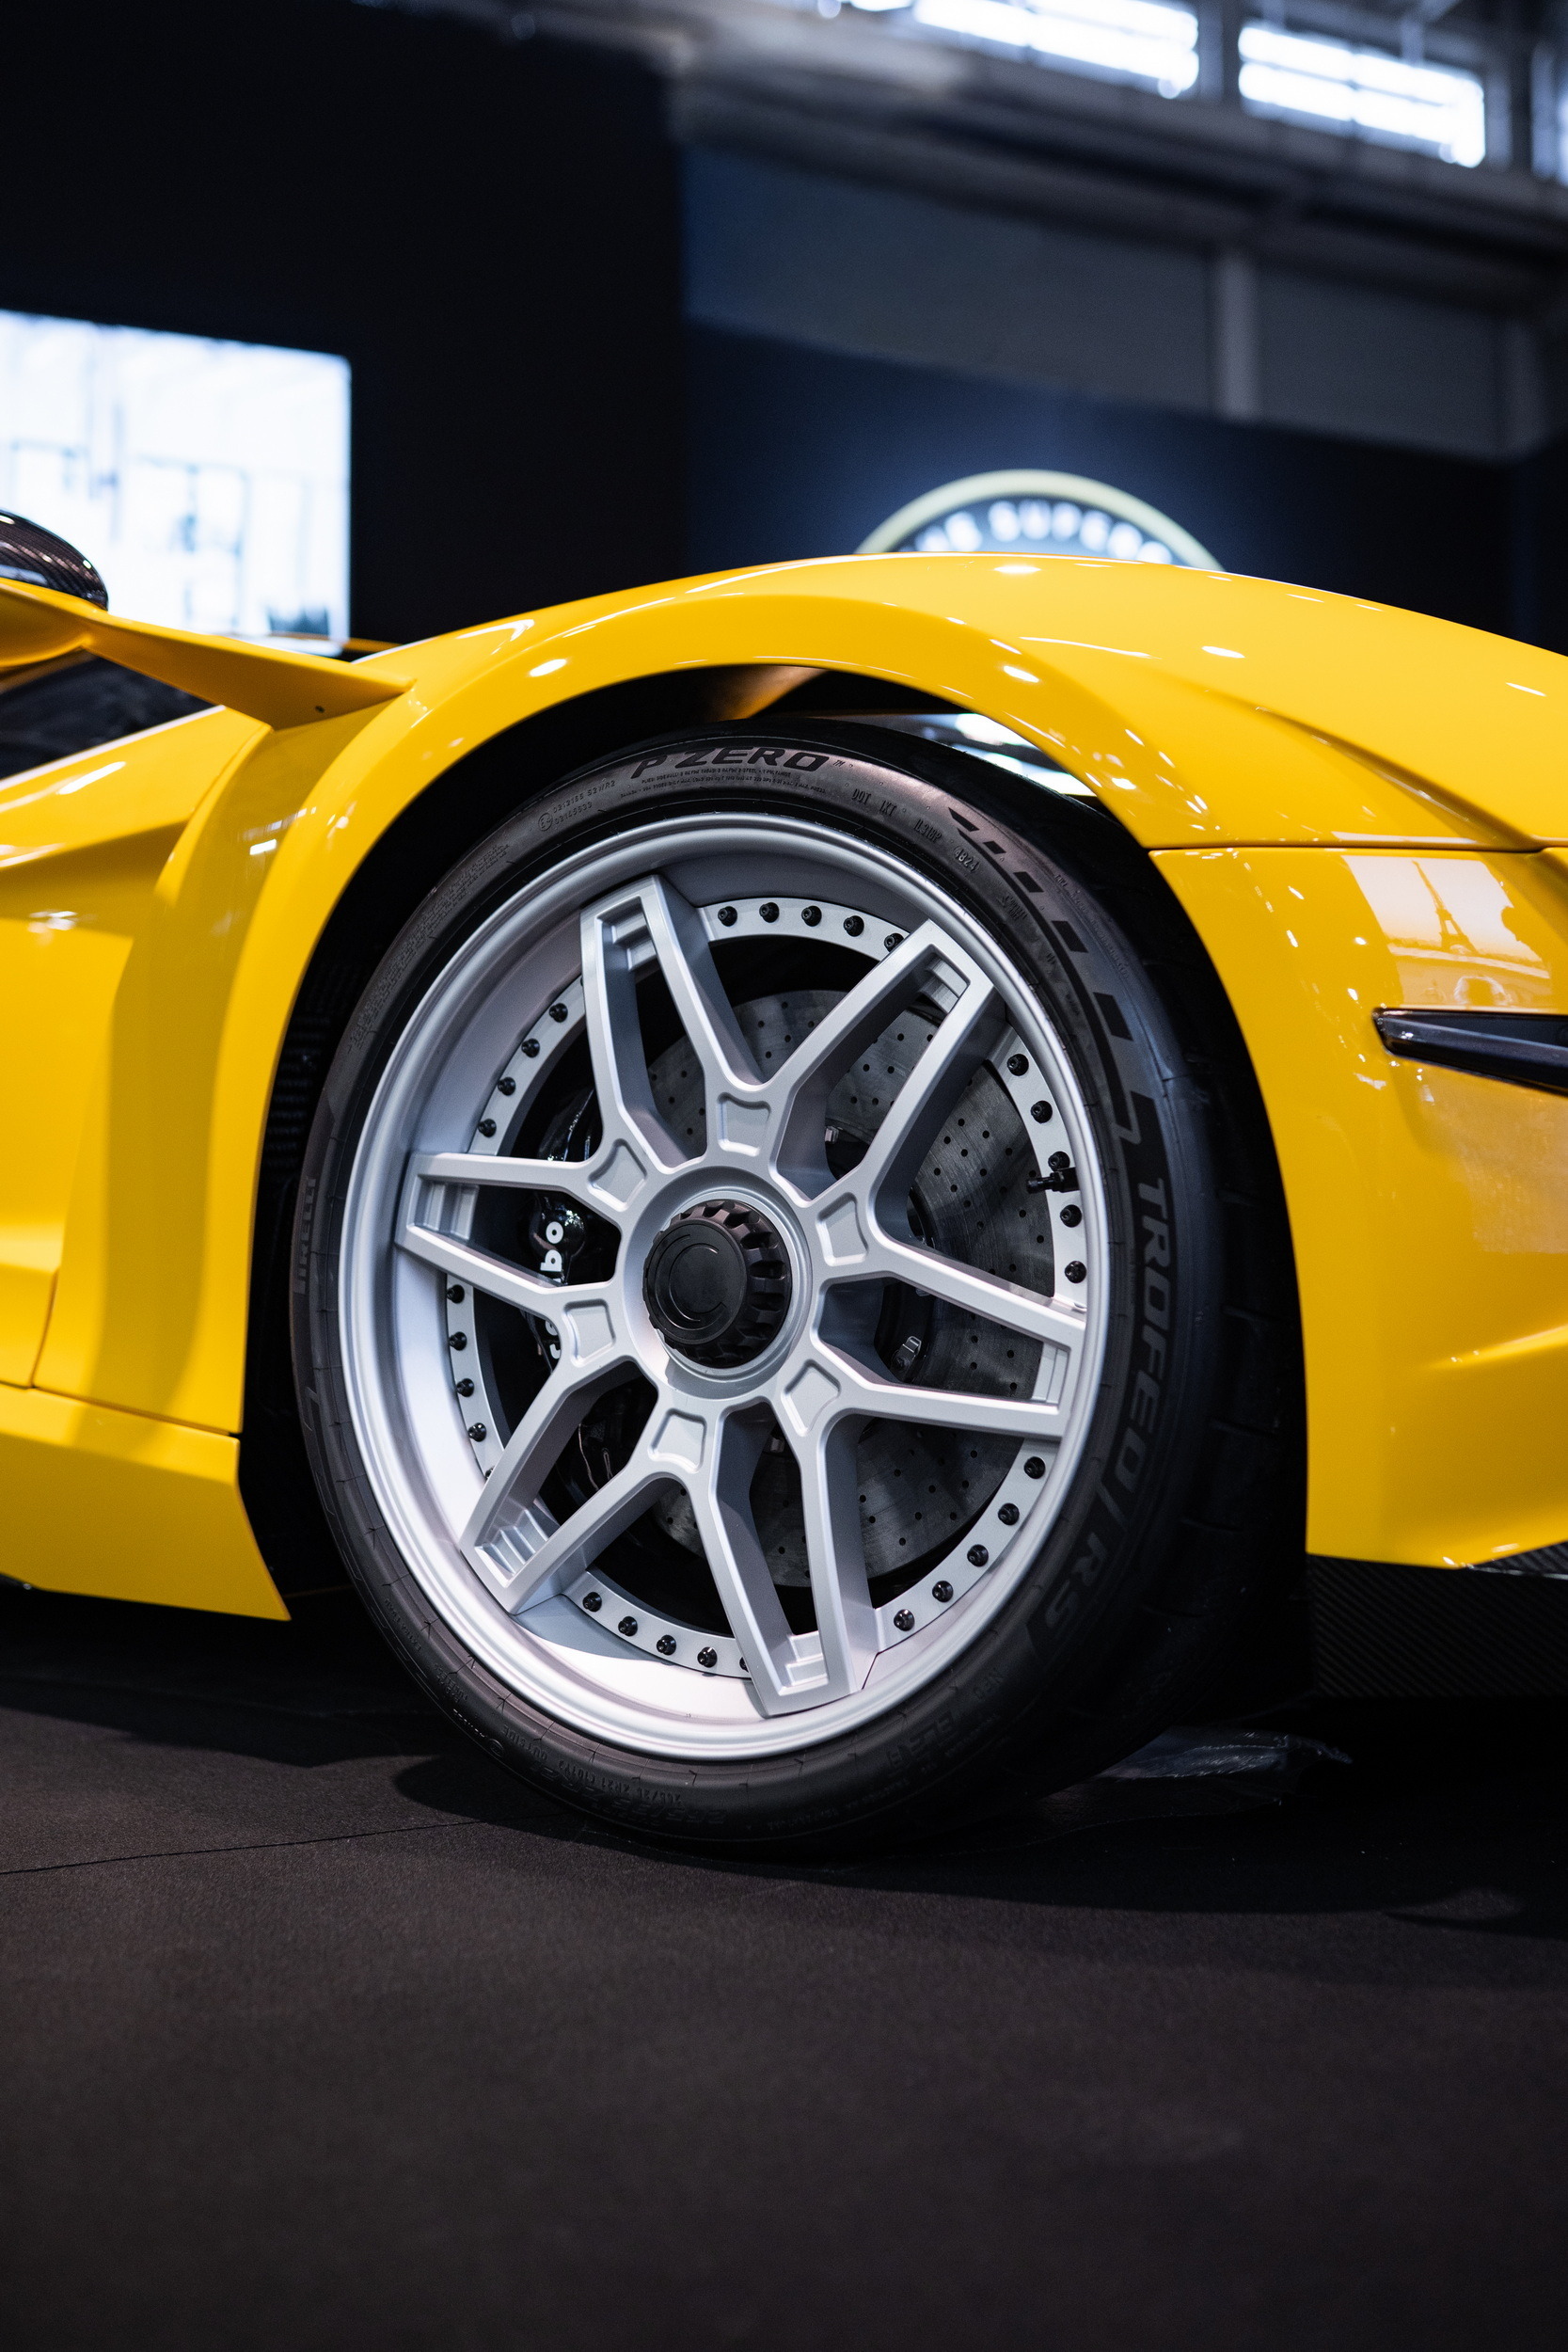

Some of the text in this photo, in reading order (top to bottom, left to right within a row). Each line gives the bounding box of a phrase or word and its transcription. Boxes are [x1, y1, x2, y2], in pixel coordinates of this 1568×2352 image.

[630, 754, 668, 779] P
[674, 746, 830, 772] ZERO
[852, 788, 872, 805] DOT
[295, 1177, 316, 1294] PIRELLI
[1119, 1177, 1172, 1493] TROFEO
[1046, 1534, 1107, 1629] RS
